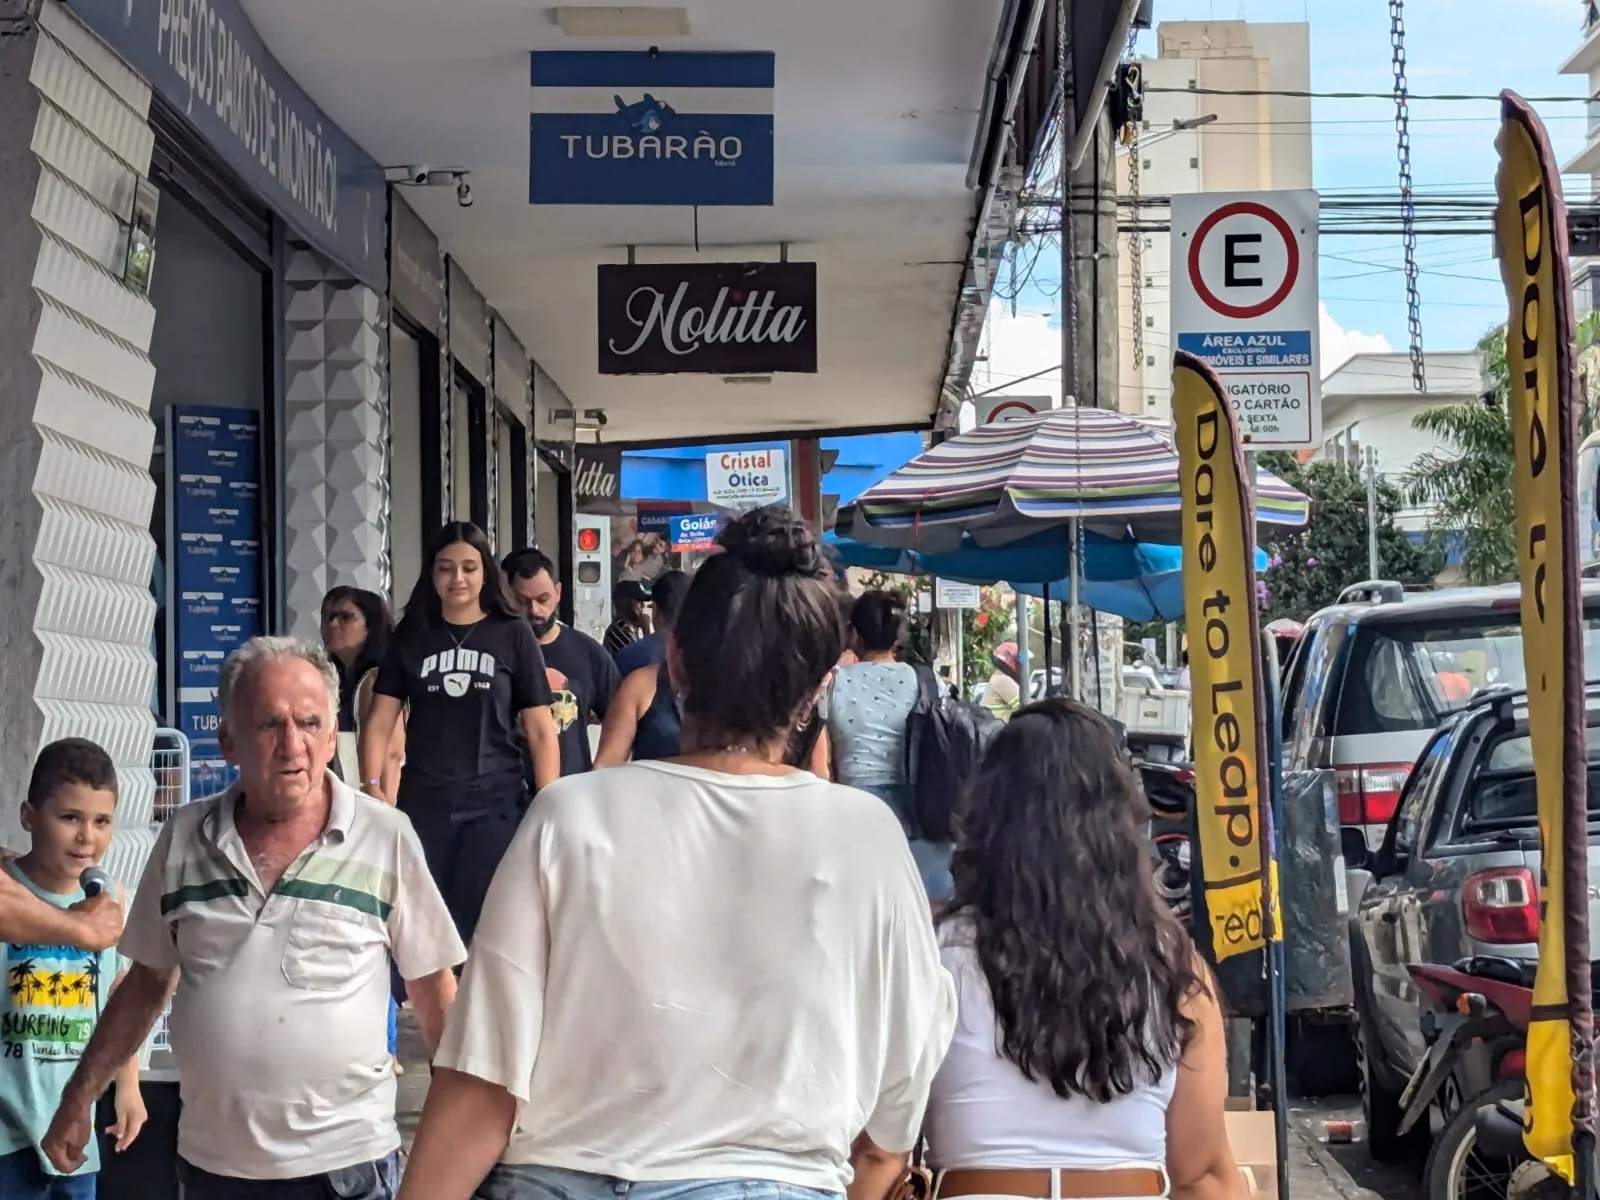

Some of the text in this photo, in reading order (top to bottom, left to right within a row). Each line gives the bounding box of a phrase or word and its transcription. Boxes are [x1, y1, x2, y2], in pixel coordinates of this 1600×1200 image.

[216, 18, 258, 155] BAIXOS
[260, 75, 276, 180] DE
[278, 98, 337, 234] MONTÃO!
[560, 130, 742, 160] TUBARÃO
[1224, 233, 1263, 287] E
[608, 281, 808, 356] Nolitta
[1202, 333, 1286, 348] ÁREA AZUL
[1204, 353, 1309, 366] MÓVEIS E SIMILARES
[1227, 382, 1291, 395] IGATÓRIO
[1244, 396, 1300, 410] CARTÃO
[1246, 414, 1278, 422] SEXTA
[721, 450, 771, 470] Cristal
[728, 471, 769, 487] Ótica
[1196, 409, 1254, 868] Dare to Leap.
[420, 648, 495, 678] PUMA
[191, 714, 222, 731] TUB
[2, 1011, 70, 1037] SURFING
[4, 1041, 24, 1059] 78
